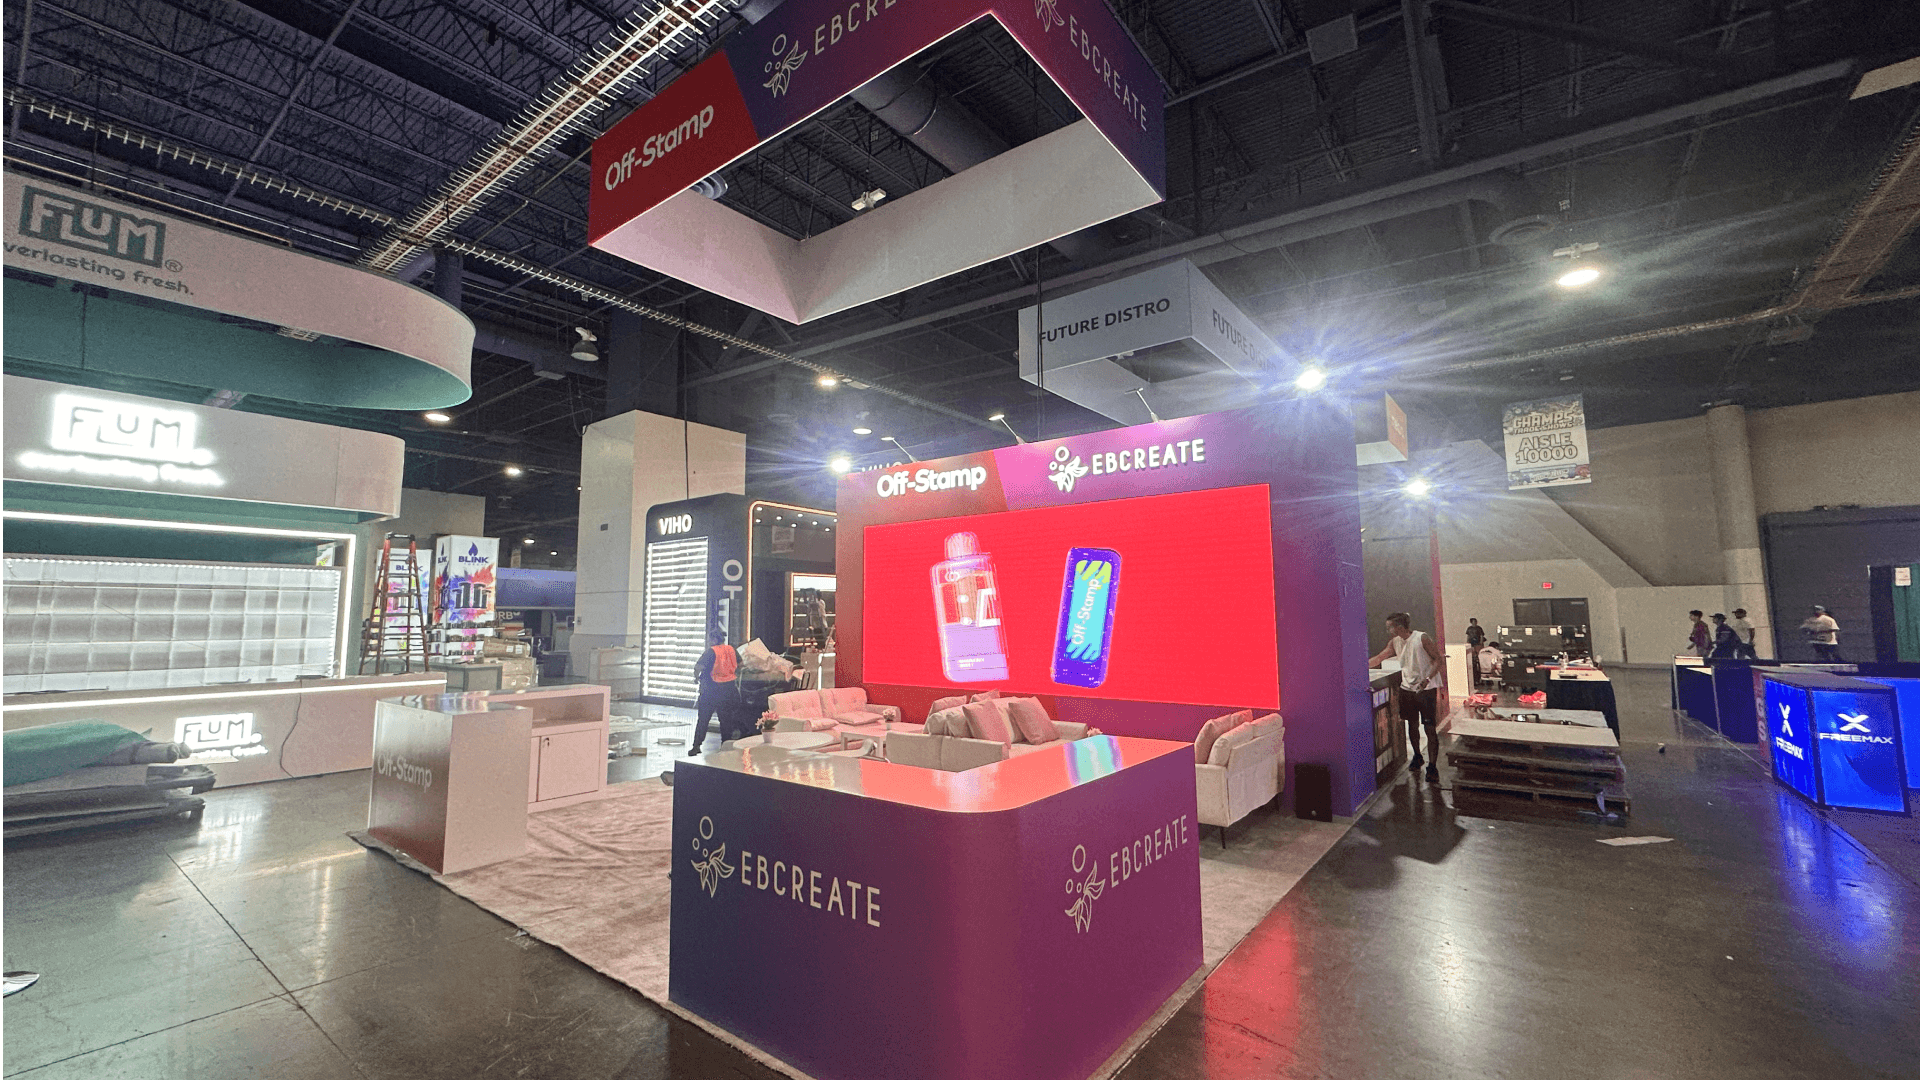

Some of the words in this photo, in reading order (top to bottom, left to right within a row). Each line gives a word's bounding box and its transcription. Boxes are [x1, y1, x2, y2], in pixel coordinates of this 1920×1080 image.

[1069, 14, 1147, 132] EBCREATE
[605, 105, 714, 191] Off-Stamp
[27, 190, 160, 265] FLUM
[3, 241, 125, 281] verlasting
[133, 270, 195, 295] fresh.
[1039, 316, 1099, 343] FUTURE
[1104, 298, 1170, 327] DISTRO
[1212, 308, 1248, 356] FUTURE
[68, 405, 182, 449] FLUM
[1513, 409, 1575, 429] CHAMPS
[1091, 438, 1207, 476] EBCREATE
[1515, 445, 1578, 465] 10000
[1519, 432, 1572, 452] AISLE
[876, 466, 987, 498] Off-Stamp
[659, 514, 693, 535] VIHO
[458, 555, 489, 563] BLINK
[1071, 578, 1099, 645] Off-Stamp
[182, 718, 245, 743] FLUM
[1819, 732, 1894, 744] FREEMAX
[377, 752, 433, 793] Off-Stamp
[1110, 814, 1188, 889] EBCREATE
[741, 850, 881, 928] EBCREATE
